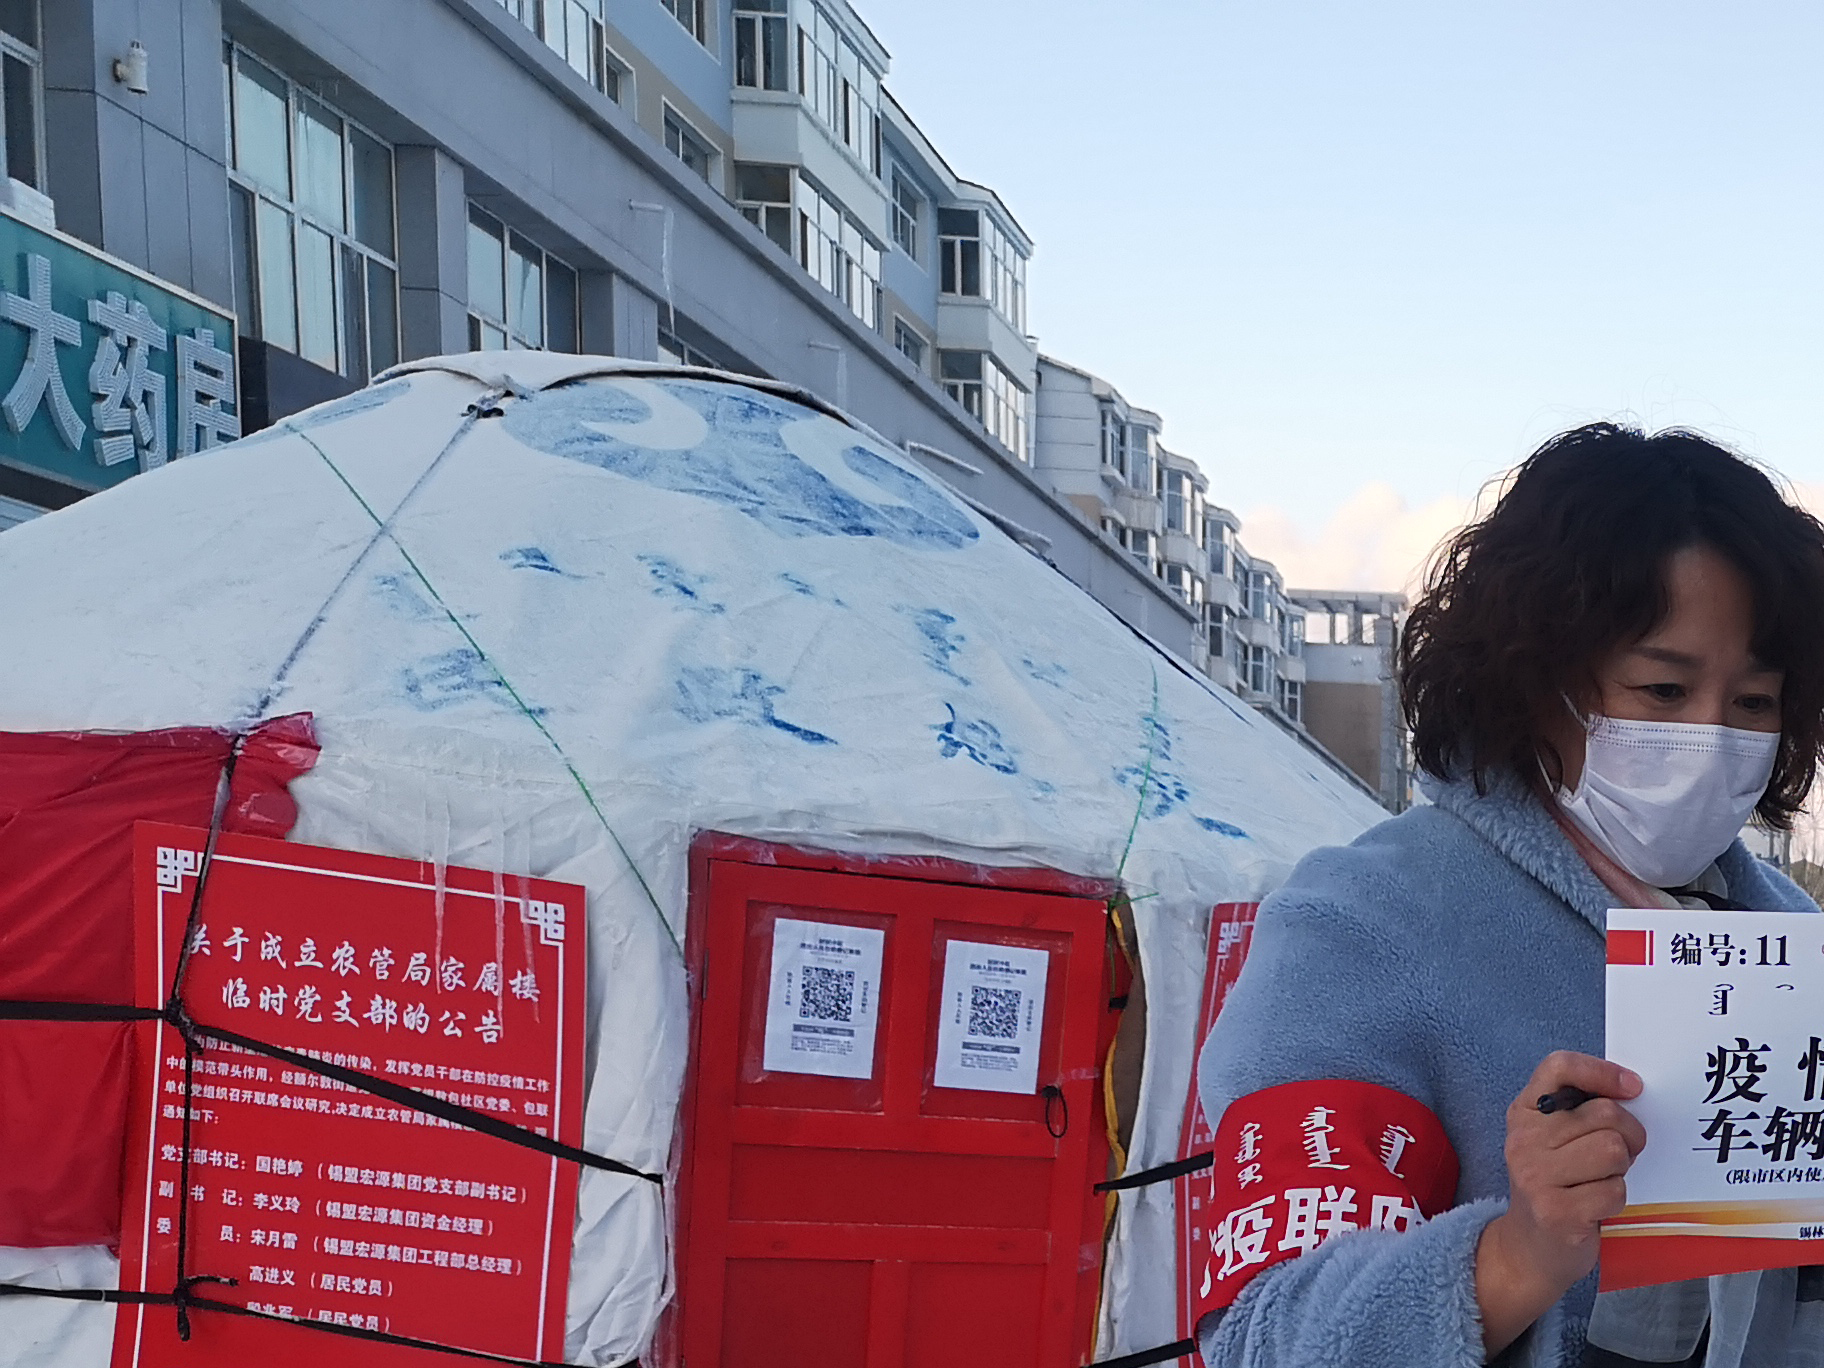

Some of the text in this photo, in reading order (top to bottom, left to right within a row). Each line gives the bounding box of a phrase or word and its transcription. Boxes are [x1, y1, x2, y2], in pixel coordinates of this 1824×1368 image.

[222, 977, 501, 1044] 临时党支部的公告
